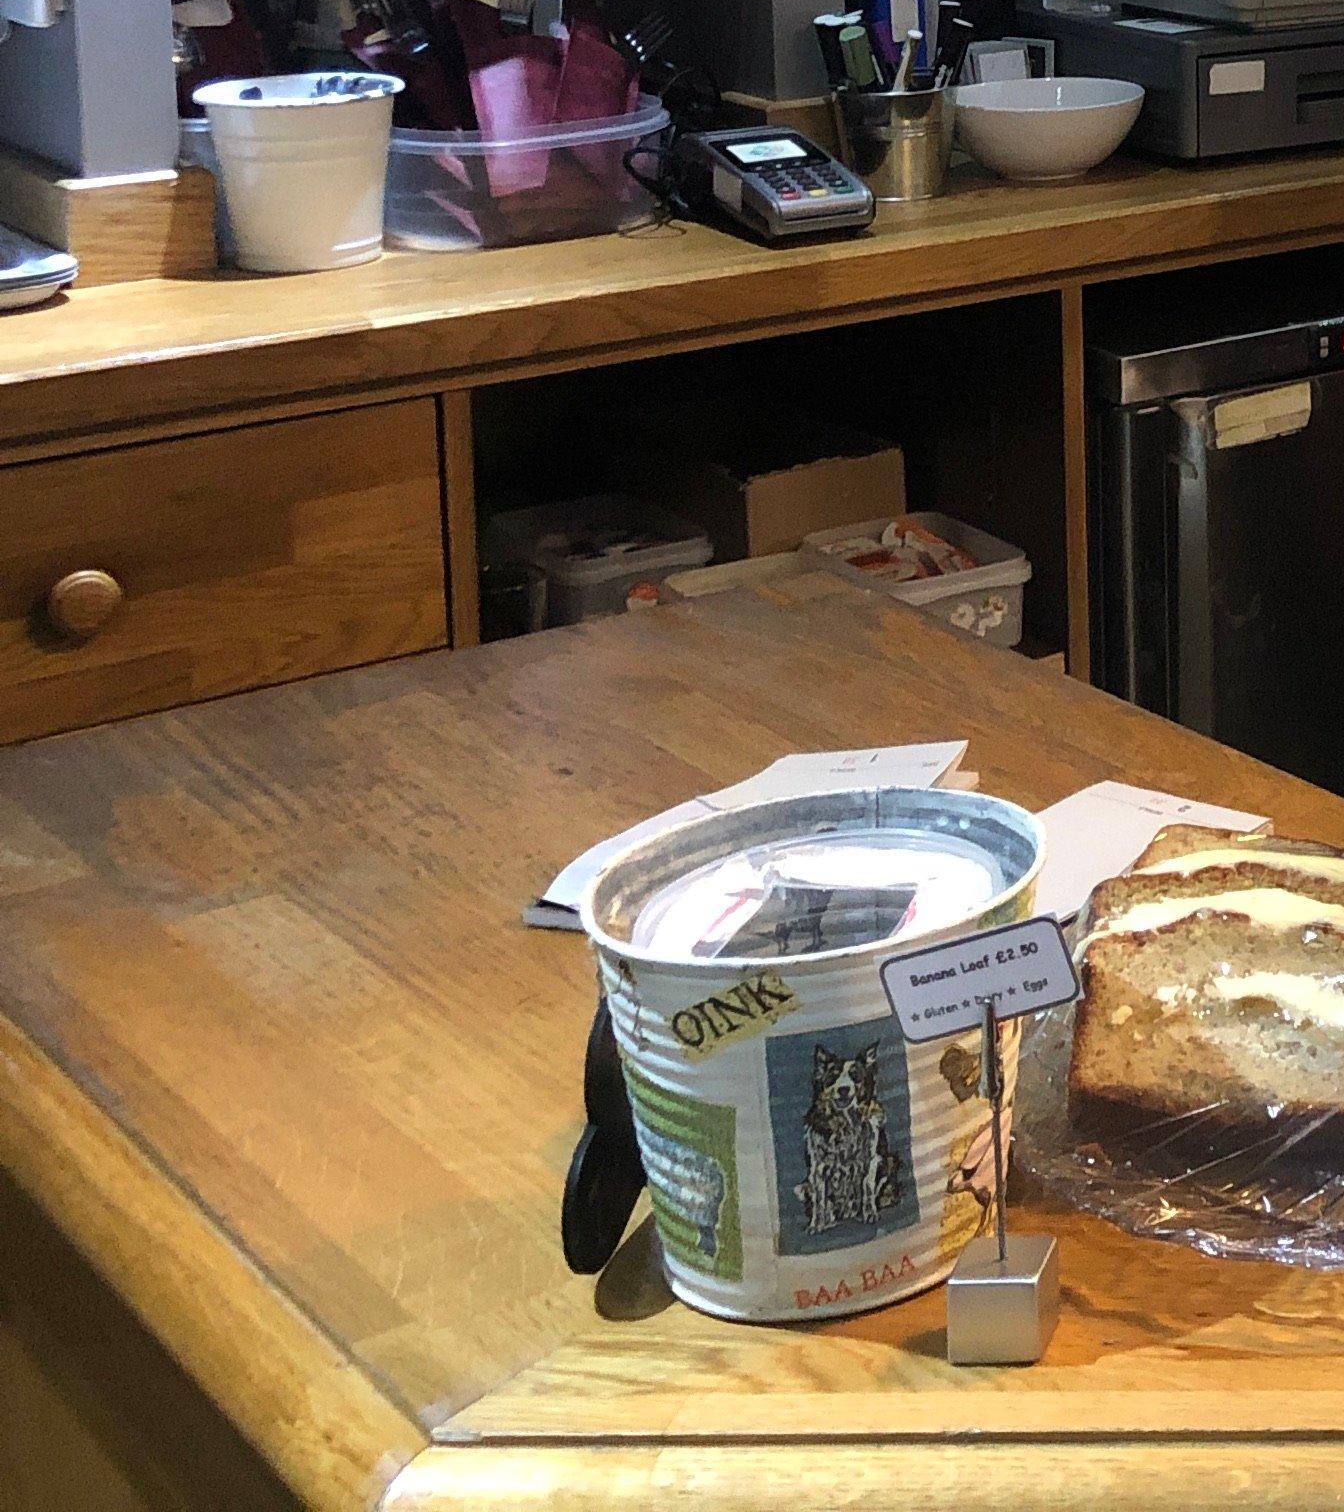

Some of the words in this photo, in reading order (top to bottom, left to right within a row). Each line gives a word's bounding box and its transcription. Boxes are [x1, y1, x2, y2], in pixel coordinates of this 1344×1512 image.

[908, 966, 958, 988] Banana
[960, 953, 990, 975] Loaf
[995, 941, 1040, 964] £2.50
[672, 970, 794, 1048] OINK
[923, 1001, 959, 1020] Gluten
[1022, 976, 1050, 994] Eggs
[794, 1278, 854, 1310] BAA
[860, 1254, 917, 1293] BAA
